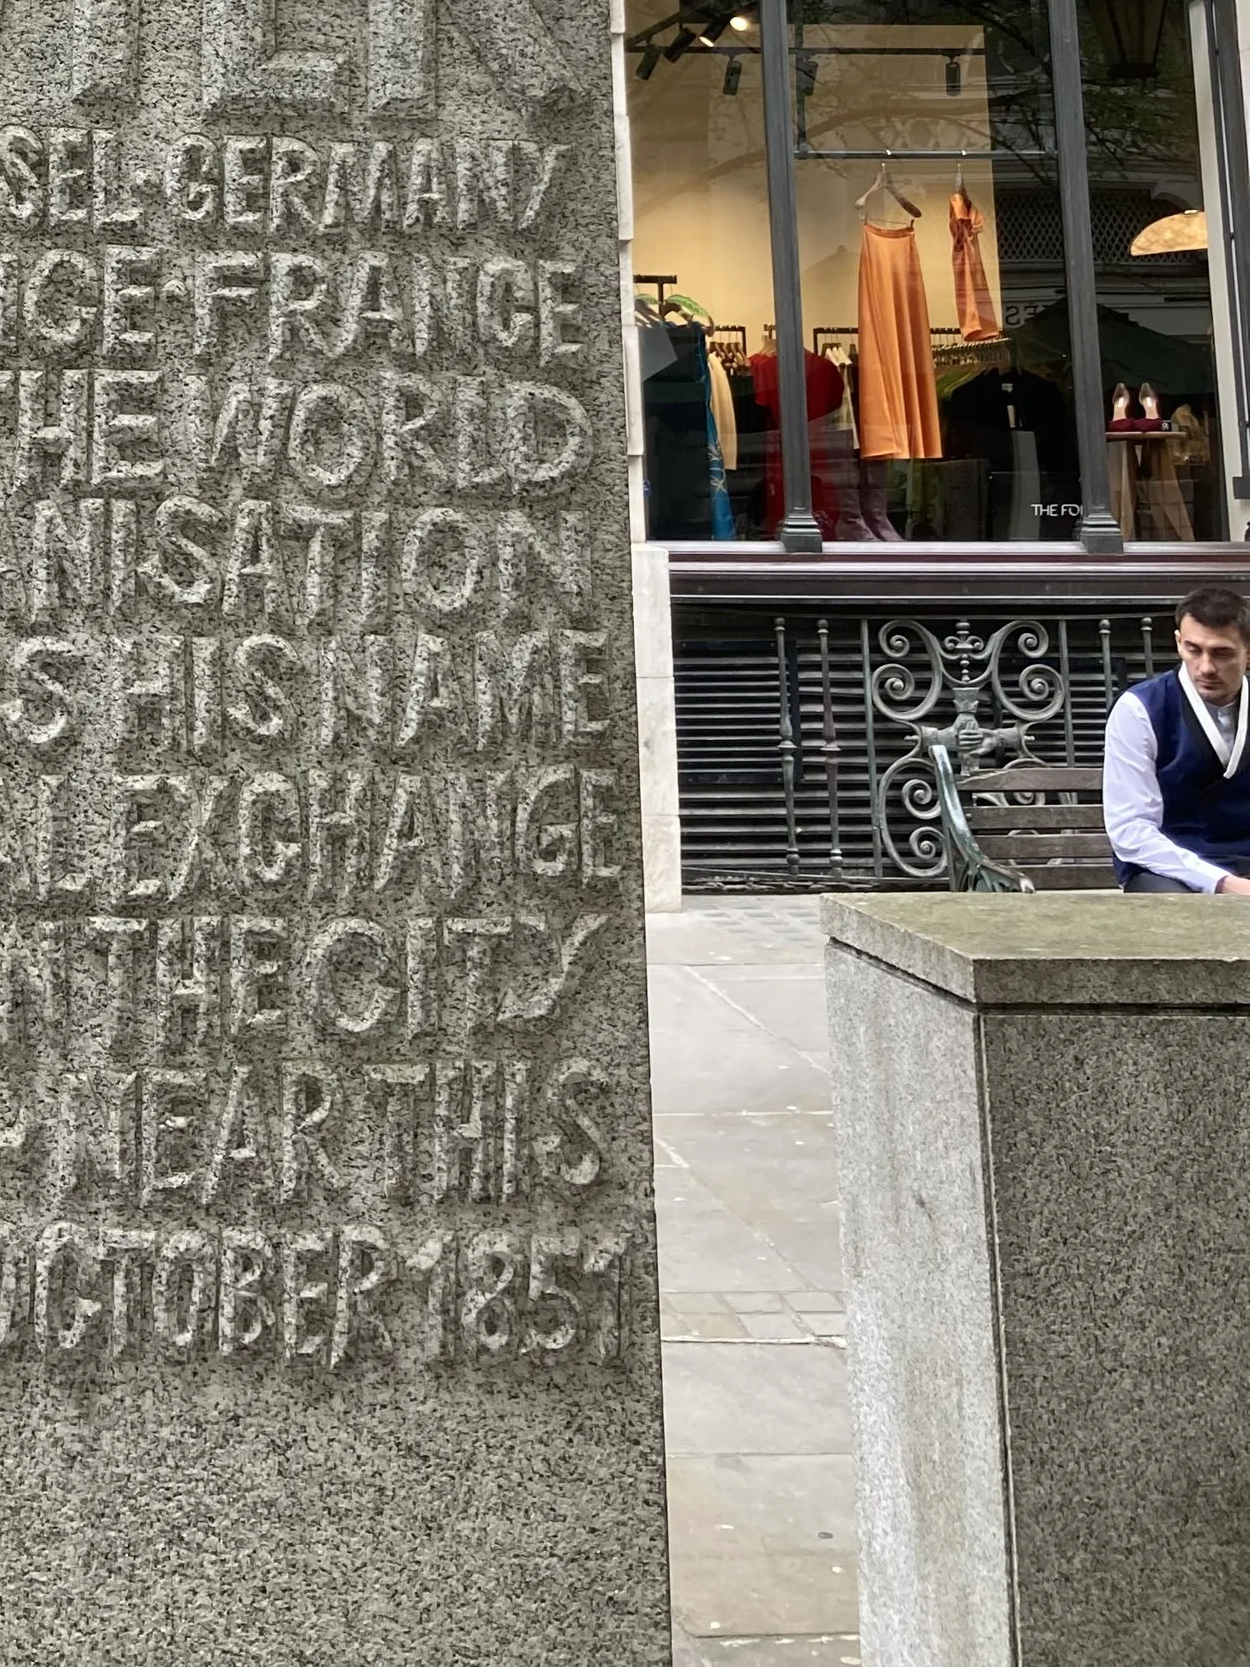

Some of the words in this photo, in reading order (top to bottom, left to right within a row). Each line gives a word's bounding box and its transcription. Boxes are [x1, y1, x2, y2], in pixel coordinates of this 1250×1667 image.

[164, 131, 574, 235] GERMANY
[191, 250, 588, 368] FRANCE
[183, 372, 595, 495] WORLD
[1030, 504, 1058, 517] THE
[116, 633, 303, 756] HIS
[318, 631, 612, 752] NAME
[112, 769, 624, 904] EXCHANGE
[86, 914, 289, 1040] THE
[305, 912, 611, 1038] CITY
[58, 1061, 349, 1206] NEAR
[361, 1056, 610, 1207] THIS
[402, 1231, 632, 1367] 1851
